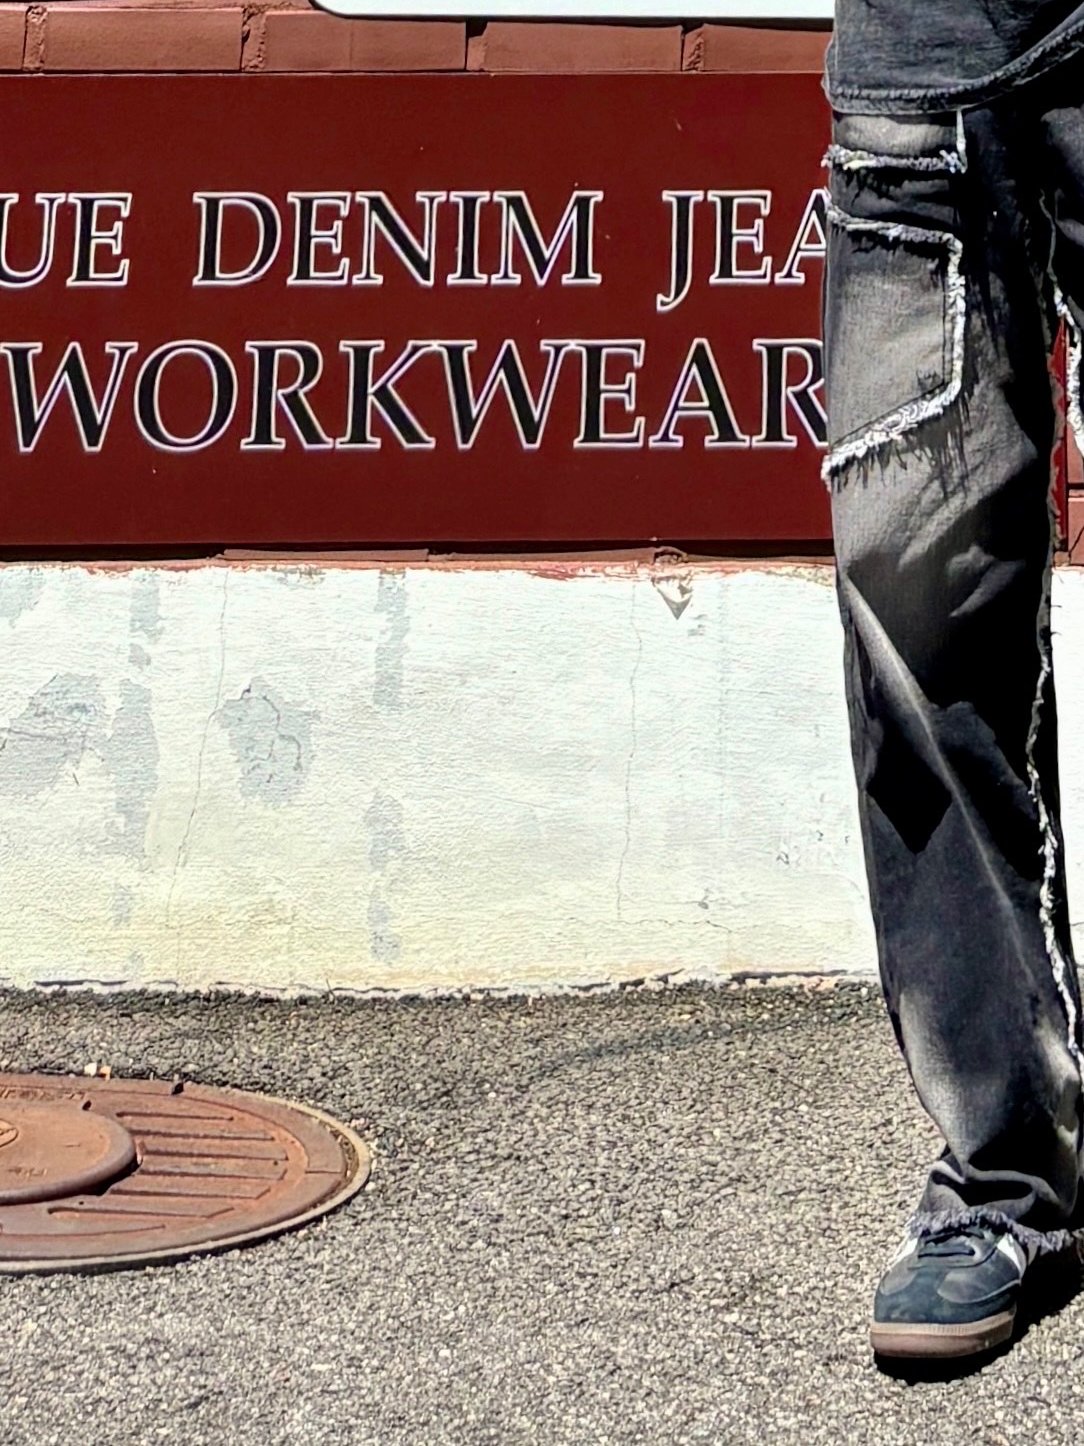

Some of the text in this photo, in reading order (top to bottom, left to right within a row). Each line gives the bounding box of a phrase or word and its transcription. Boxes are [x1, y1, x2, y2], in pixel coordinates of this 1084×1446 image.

[0, 192, 133, 288] UE
[192, 190, 604, 288] DENIM
[0, 336, 829, 453] WORKWEAR
